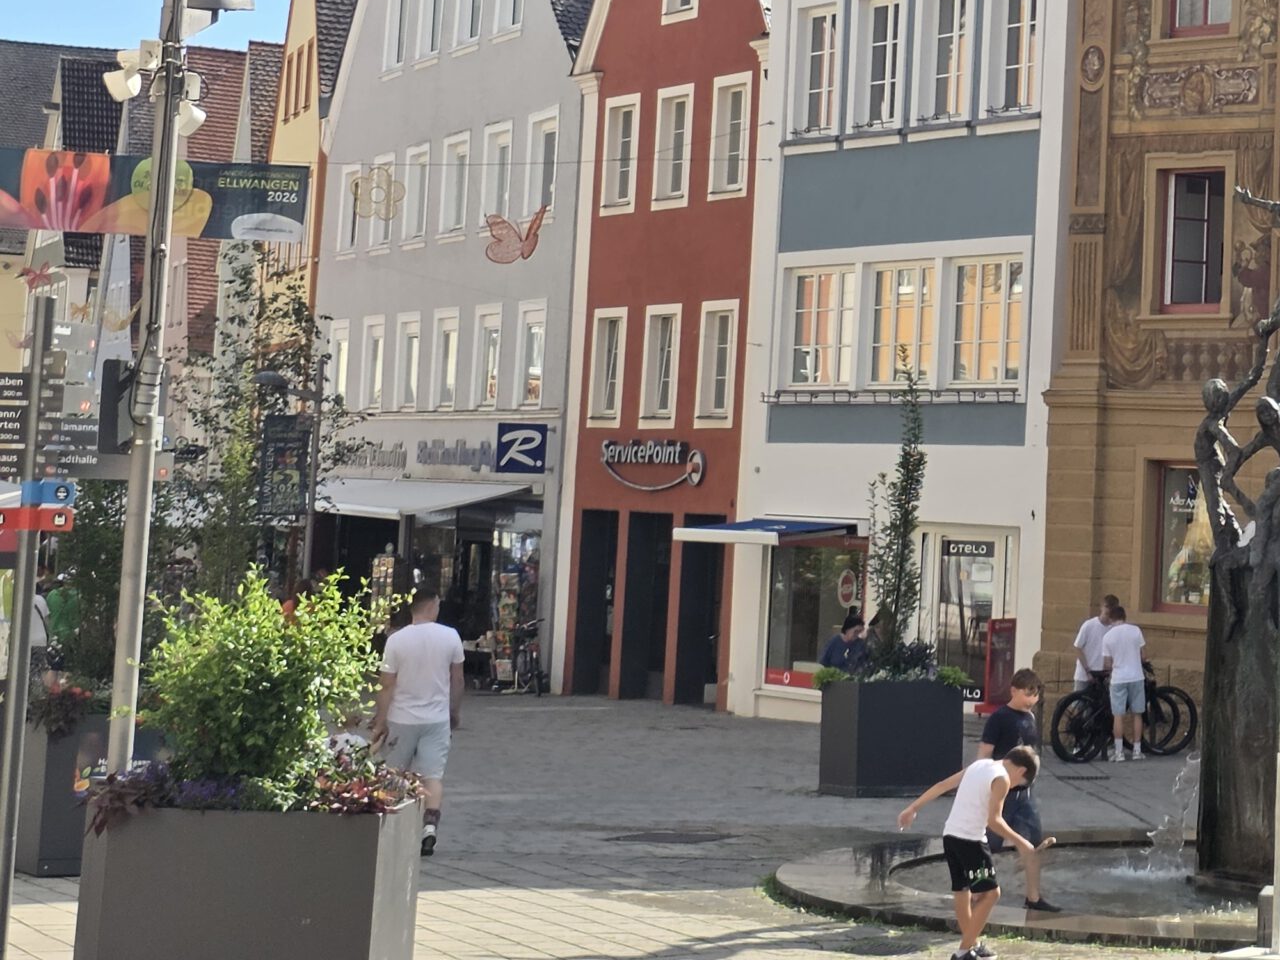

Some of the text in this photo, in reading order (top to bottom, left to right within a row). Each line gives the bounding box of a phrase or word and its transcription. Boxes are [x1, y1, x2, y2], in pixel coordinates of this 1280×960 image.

[217, 176, 299, 191] ELLWANGEN
[267, 191, 298, 203] 2026
[60, 421, 99, 432] lamanne
[0, 454, 18, 462] aus
[601, 439, 681, 465] ServicePoint
[59, 454, 98, 465] adthalle
[262, 446, 275, 513] ELLWANGEN
